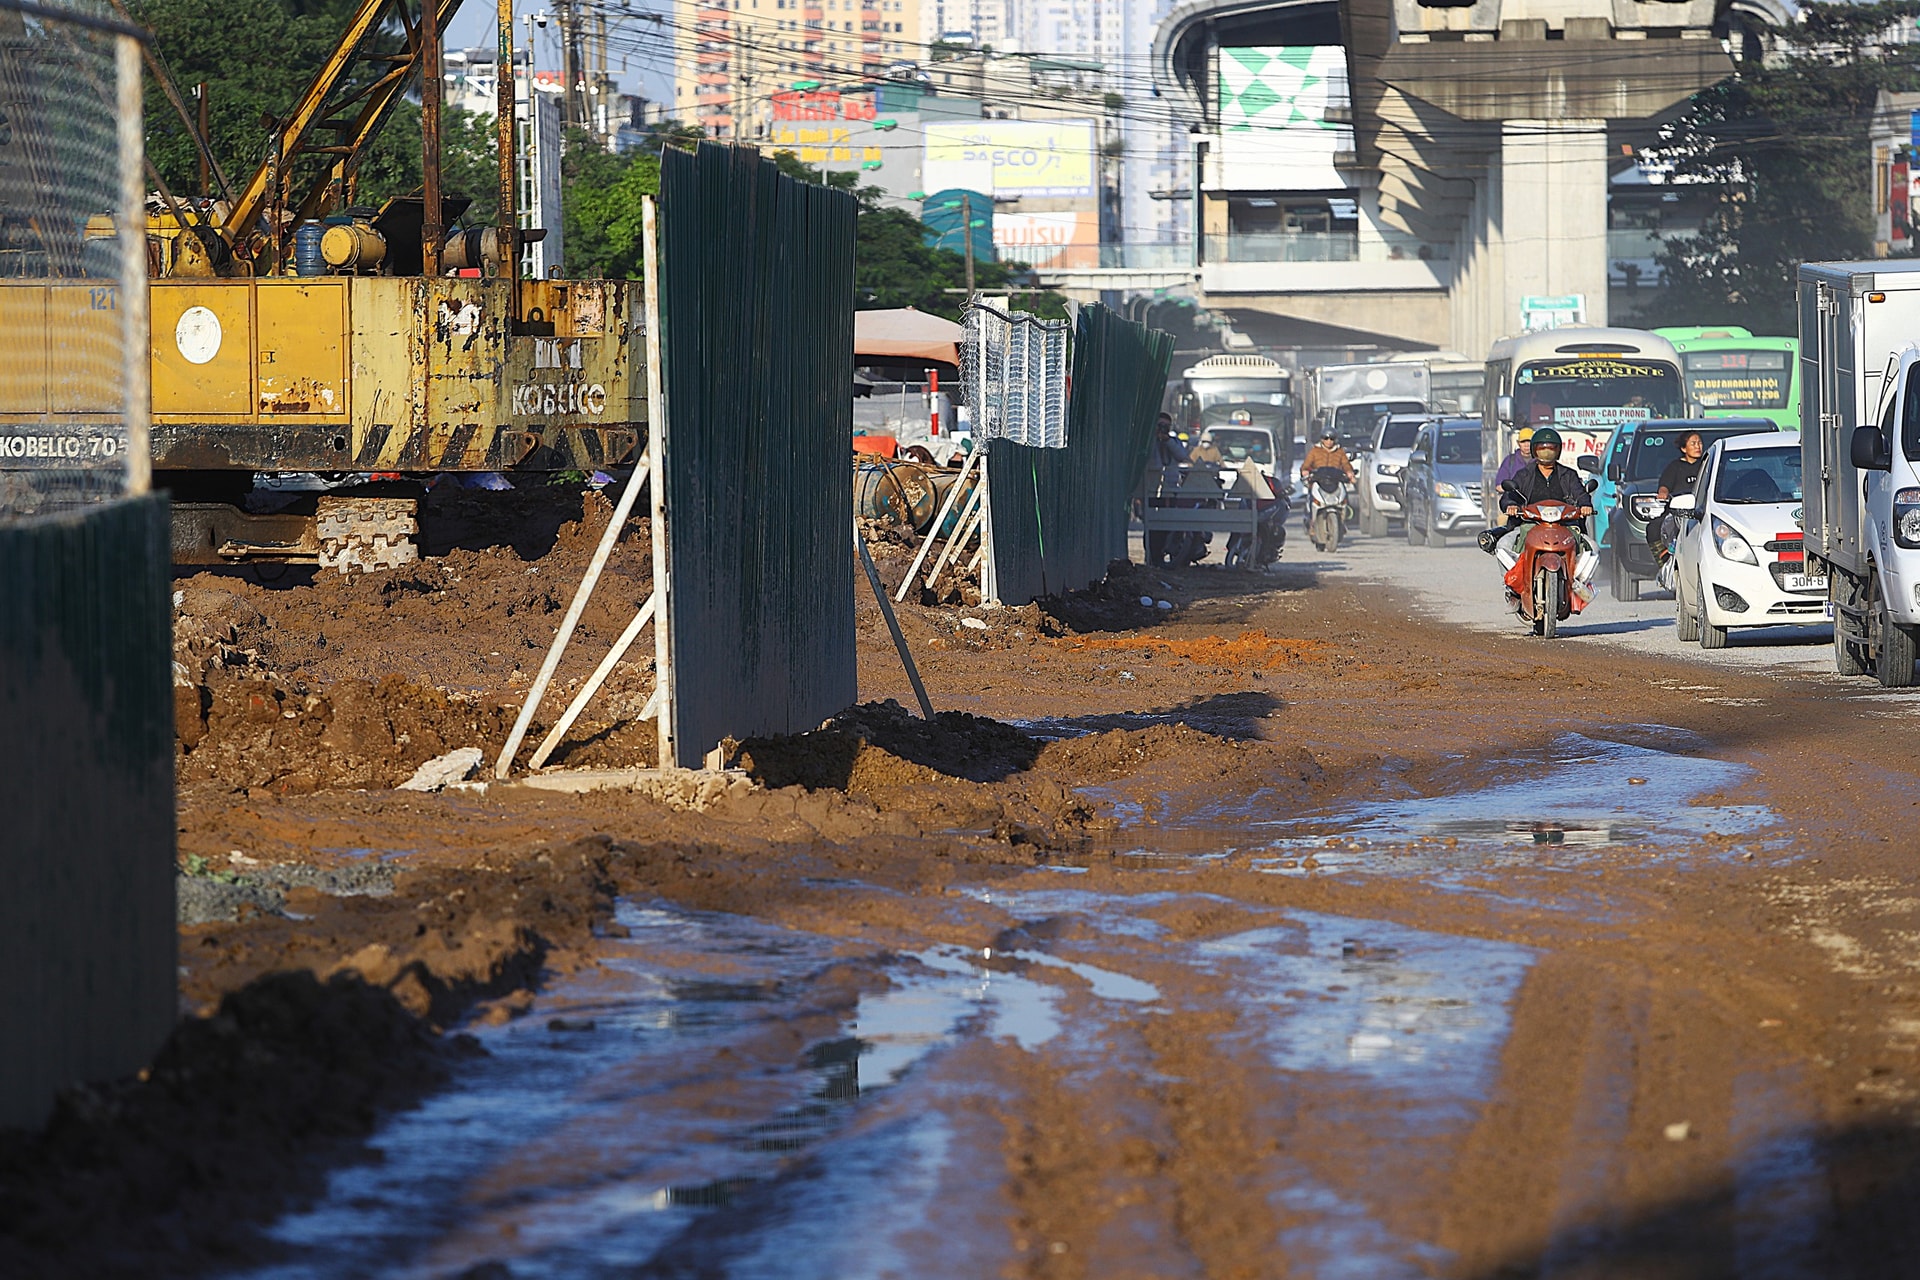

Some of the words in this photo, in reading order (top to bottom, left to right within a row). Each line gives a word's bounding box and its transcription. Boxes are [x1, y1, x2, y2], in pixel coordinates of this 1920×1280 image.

[88, 287, 116, 311] 121
[1533, 367, 1665, 377] LIMOUSINE
[1602, 409, 1617, 418] CAO
[1619, 409, 1646, 418] PHONG
